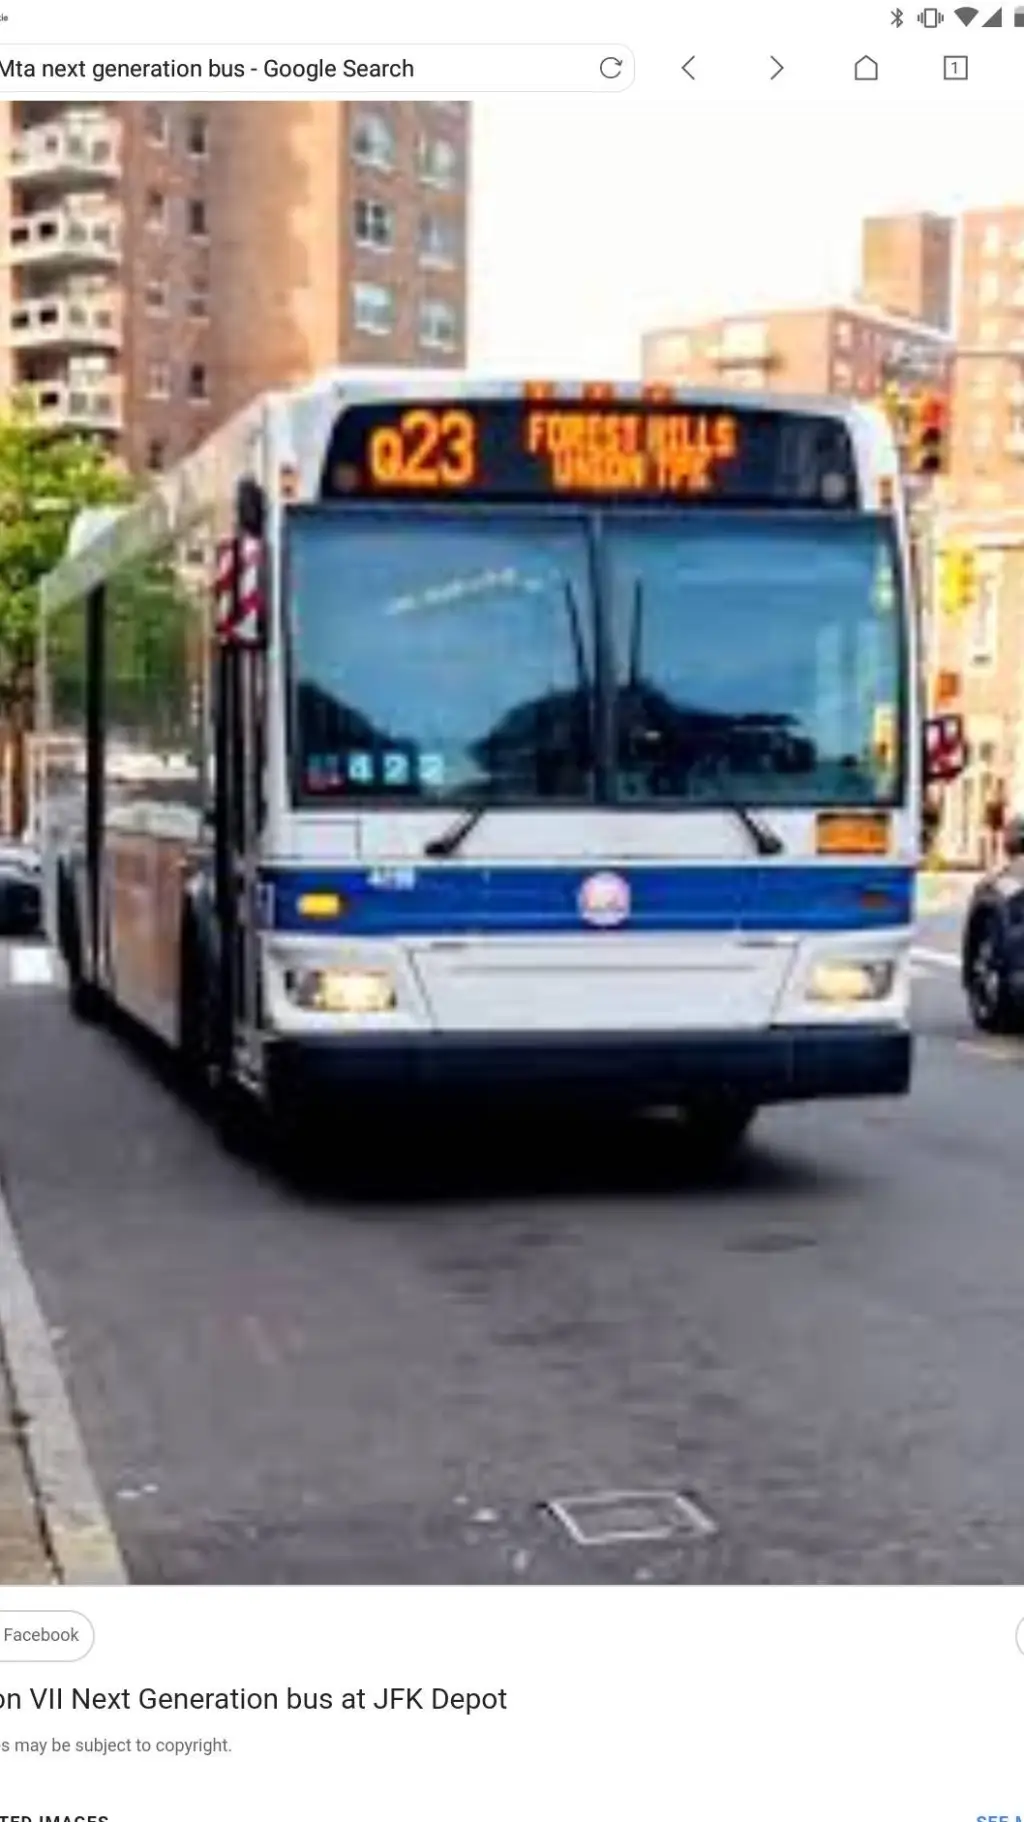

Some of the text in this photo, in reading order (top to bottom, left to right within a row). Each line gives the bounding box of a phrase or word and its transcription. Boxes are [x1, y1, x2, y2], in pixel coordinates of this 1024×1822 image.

[370, 411, 476, 486] Q23
[528, 412, 737, 460] FOREST HILLS
[552, 450, 644, 489] UNION
